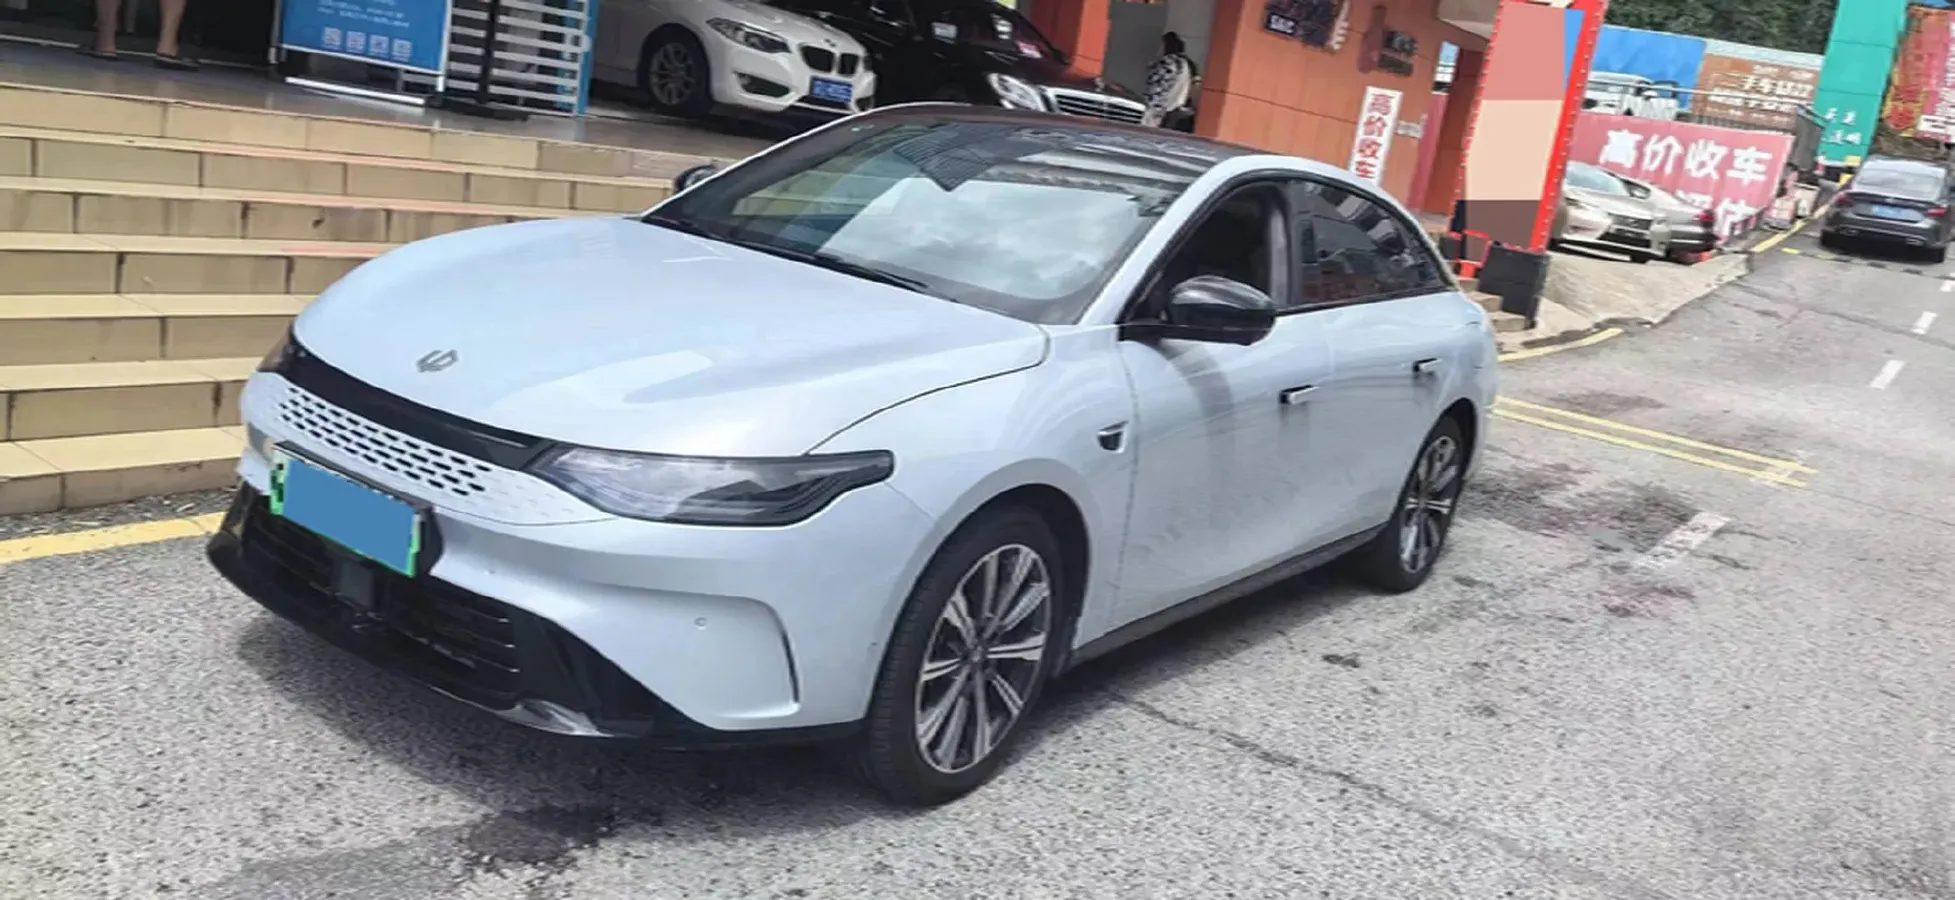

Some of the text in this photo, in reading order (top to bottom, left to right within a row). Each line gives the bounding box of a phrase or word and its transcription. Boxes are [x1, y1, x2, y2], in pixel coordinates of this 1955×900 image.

[1355, 93, 1395, 179] 高价收车
[1599, 128, 1773, 184] 高价收车
